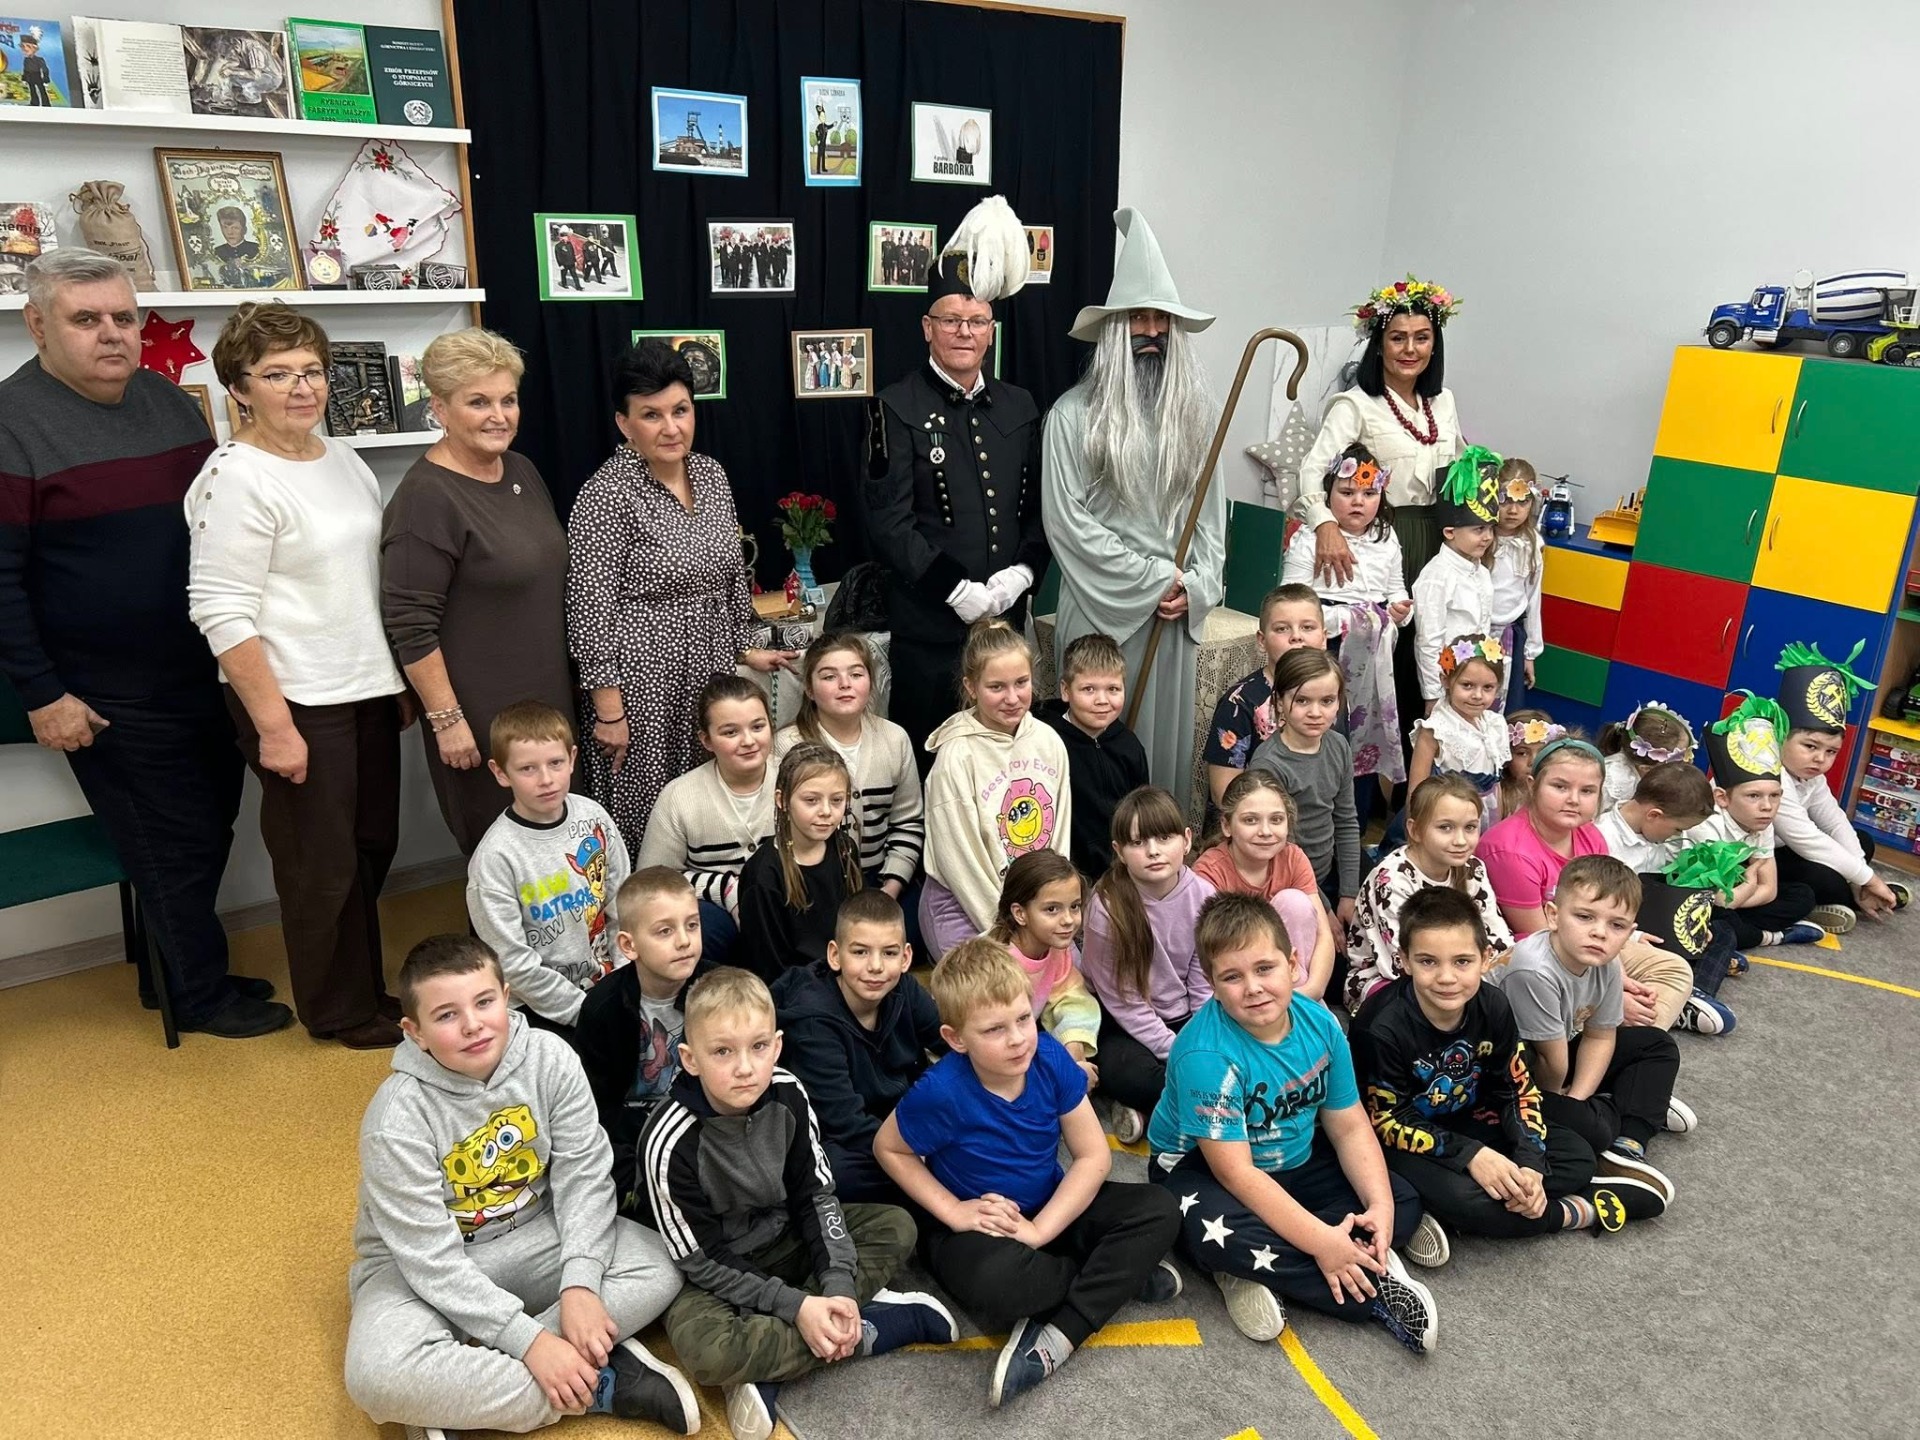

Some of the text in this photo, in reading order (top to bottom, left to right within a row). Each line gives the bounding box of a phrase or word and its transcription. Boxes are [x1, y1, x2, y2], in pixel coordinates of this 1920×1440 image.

[308, 106, 341, 115] FABRYKA
[320, 98, 356, 107] RYBNICKA
[933, 160, 975, 176] BARBÓRKA
[981, 770, 1007, 802] Best
[520, 869, 569, 905] PAW
[526, 913, 565, 949] PAW
